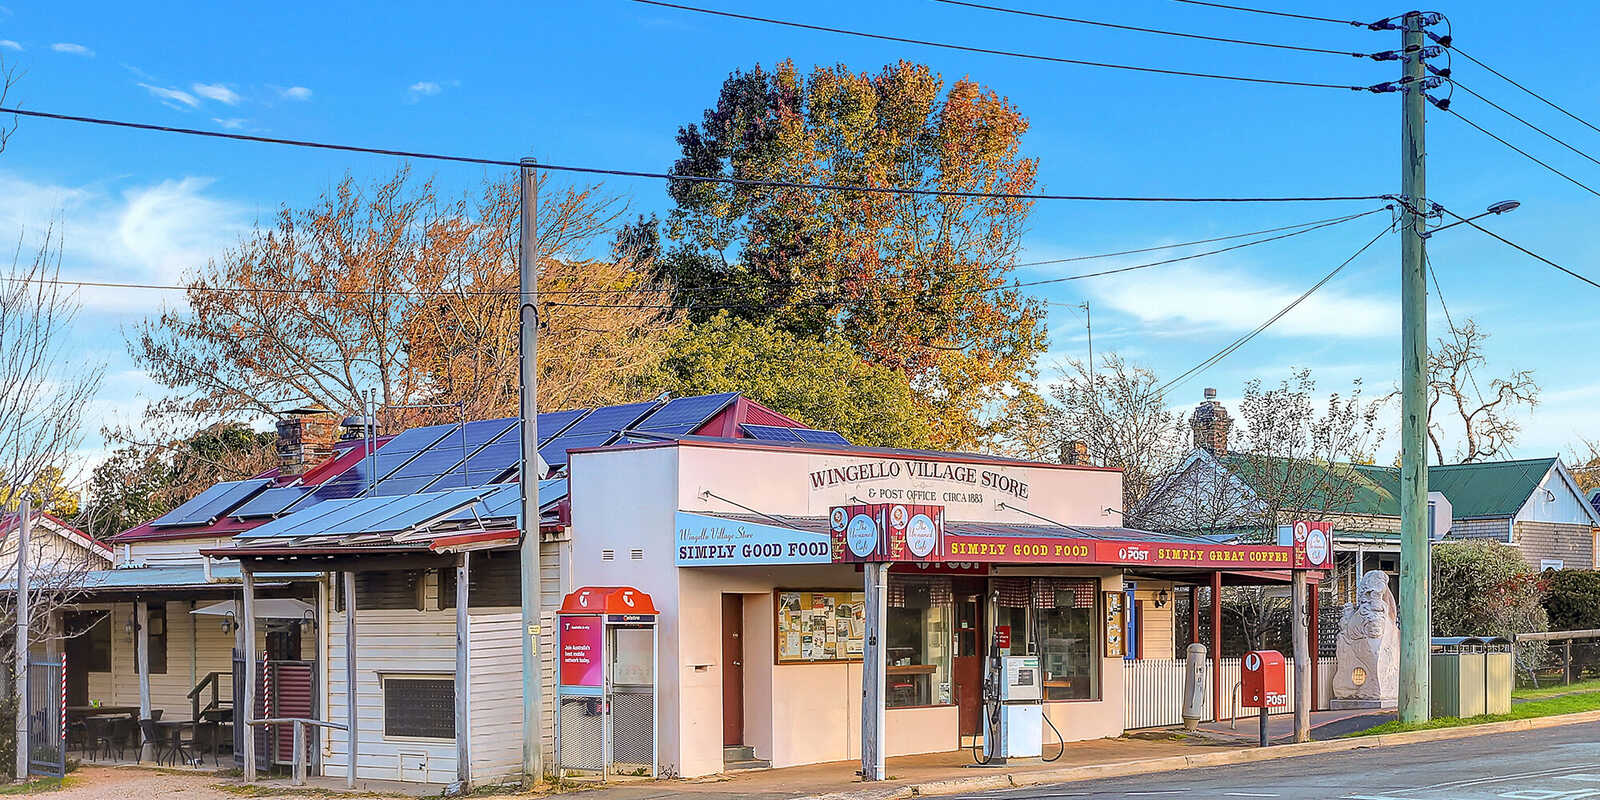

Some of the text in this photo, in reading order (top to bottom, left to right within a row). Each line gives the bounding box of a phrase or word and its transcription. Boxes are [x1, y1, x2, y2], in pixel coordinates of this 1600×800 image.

[810, 461, 1029, 499] WINGELLO VILLAGE STORE
[868, 488, 876, 498] &
[880, 488, 903, 499] POST
[906, 489, 936, 501] OFFICE
[943, 492, 966, 503] CIRCA
[679, 526, 753, 543] Wingello Village Store
[679, 544, 736, 559] SIMPLY
[742, 543, 782, 557] GOOD
[788, 542, 828, 557] FOOD
[951, 542, 1088, 557] SIMPLY GOOD FOOD
[1127, 550, 1149, 560] POST
[1158, 548, 1288, 562] SIMPLY GREAT COFFEE
[1266, 694, 1287, 705] POST
